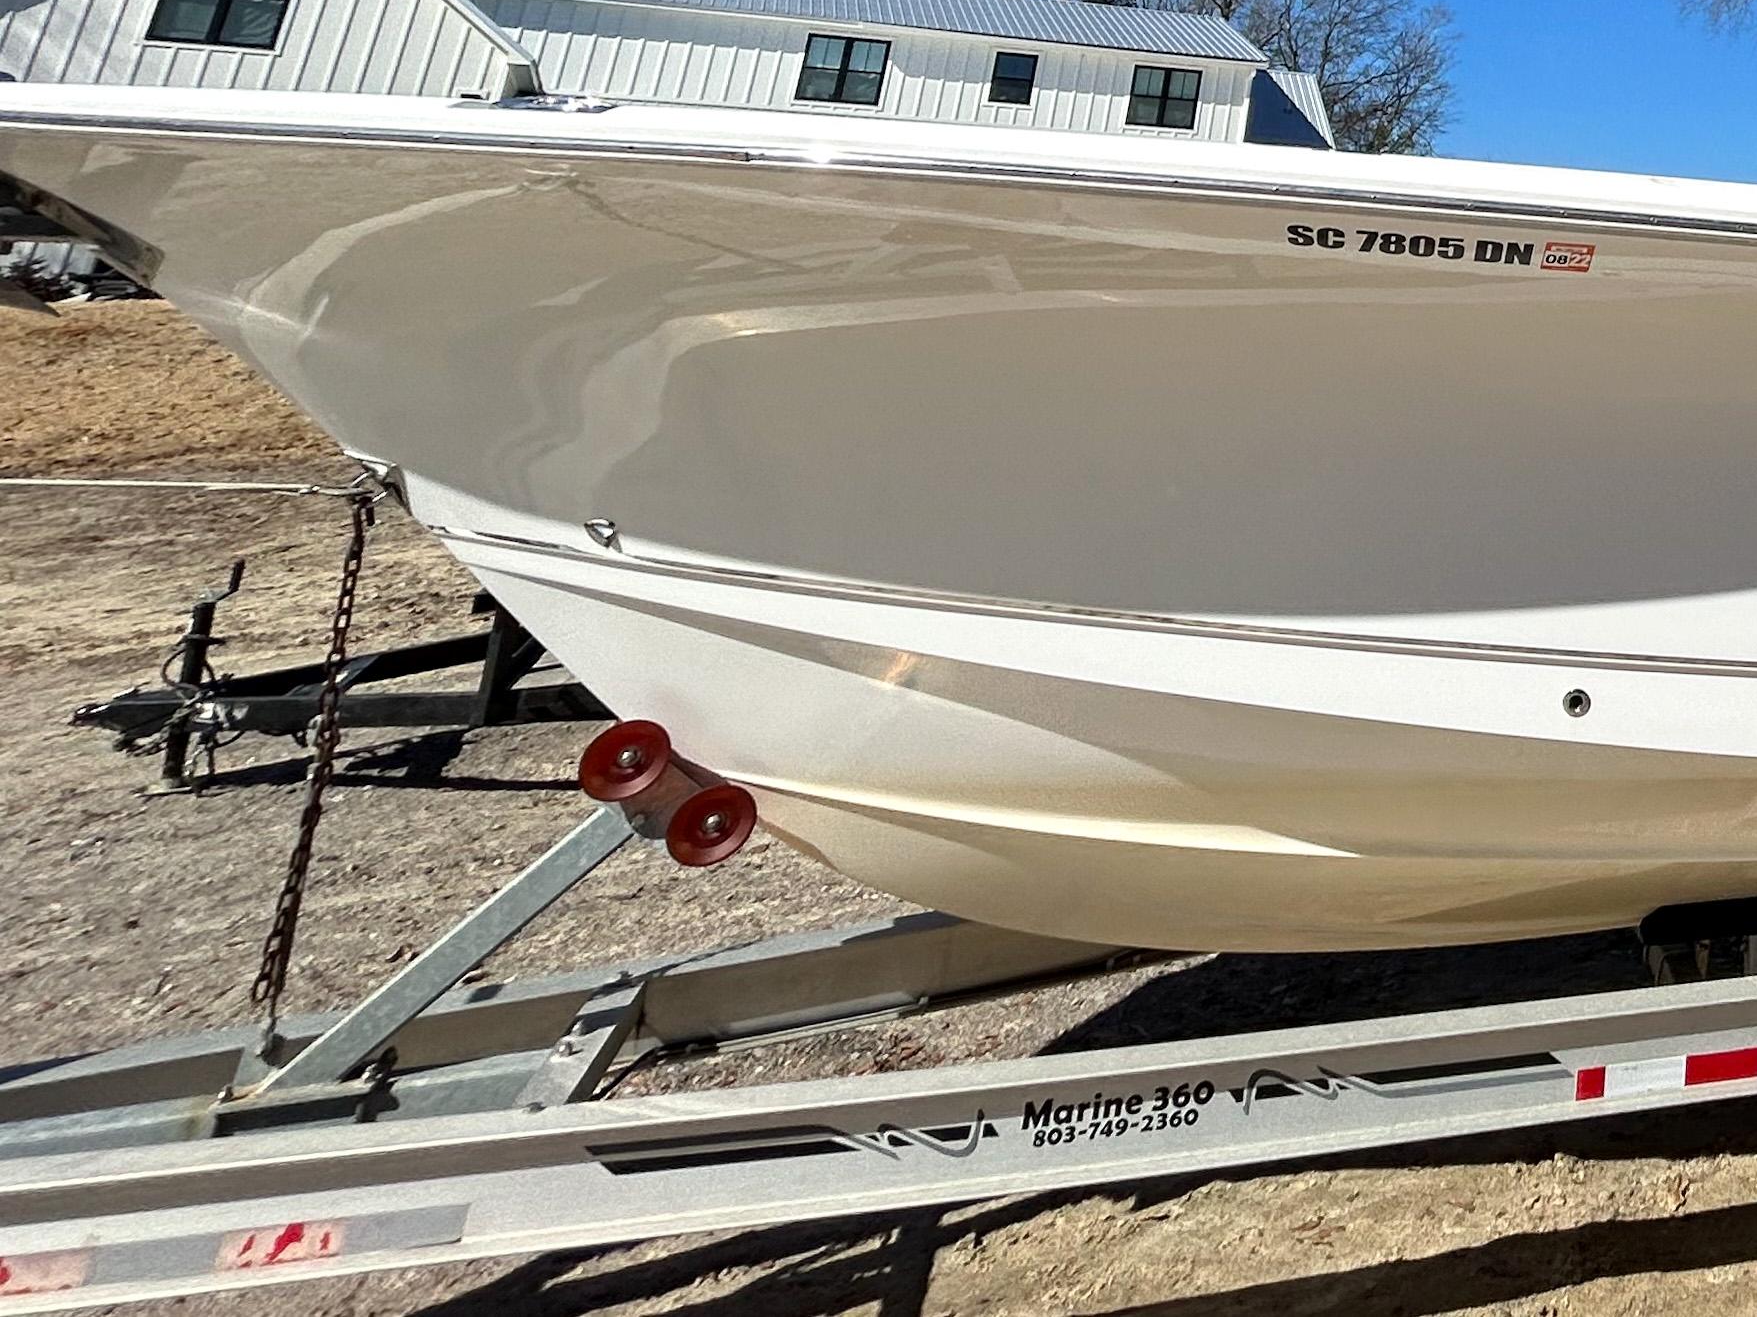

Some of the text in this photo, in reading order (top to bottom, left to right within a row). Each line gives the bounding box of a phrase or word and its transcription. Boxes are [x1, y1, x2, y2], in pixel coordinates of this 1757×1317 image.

[1287, 225, 1535, 265] SC 7805 DN
[1021, 1081, 1215, 1130] Marine 360
[1033, 1108, 1199, 1148] 803-749-2360
